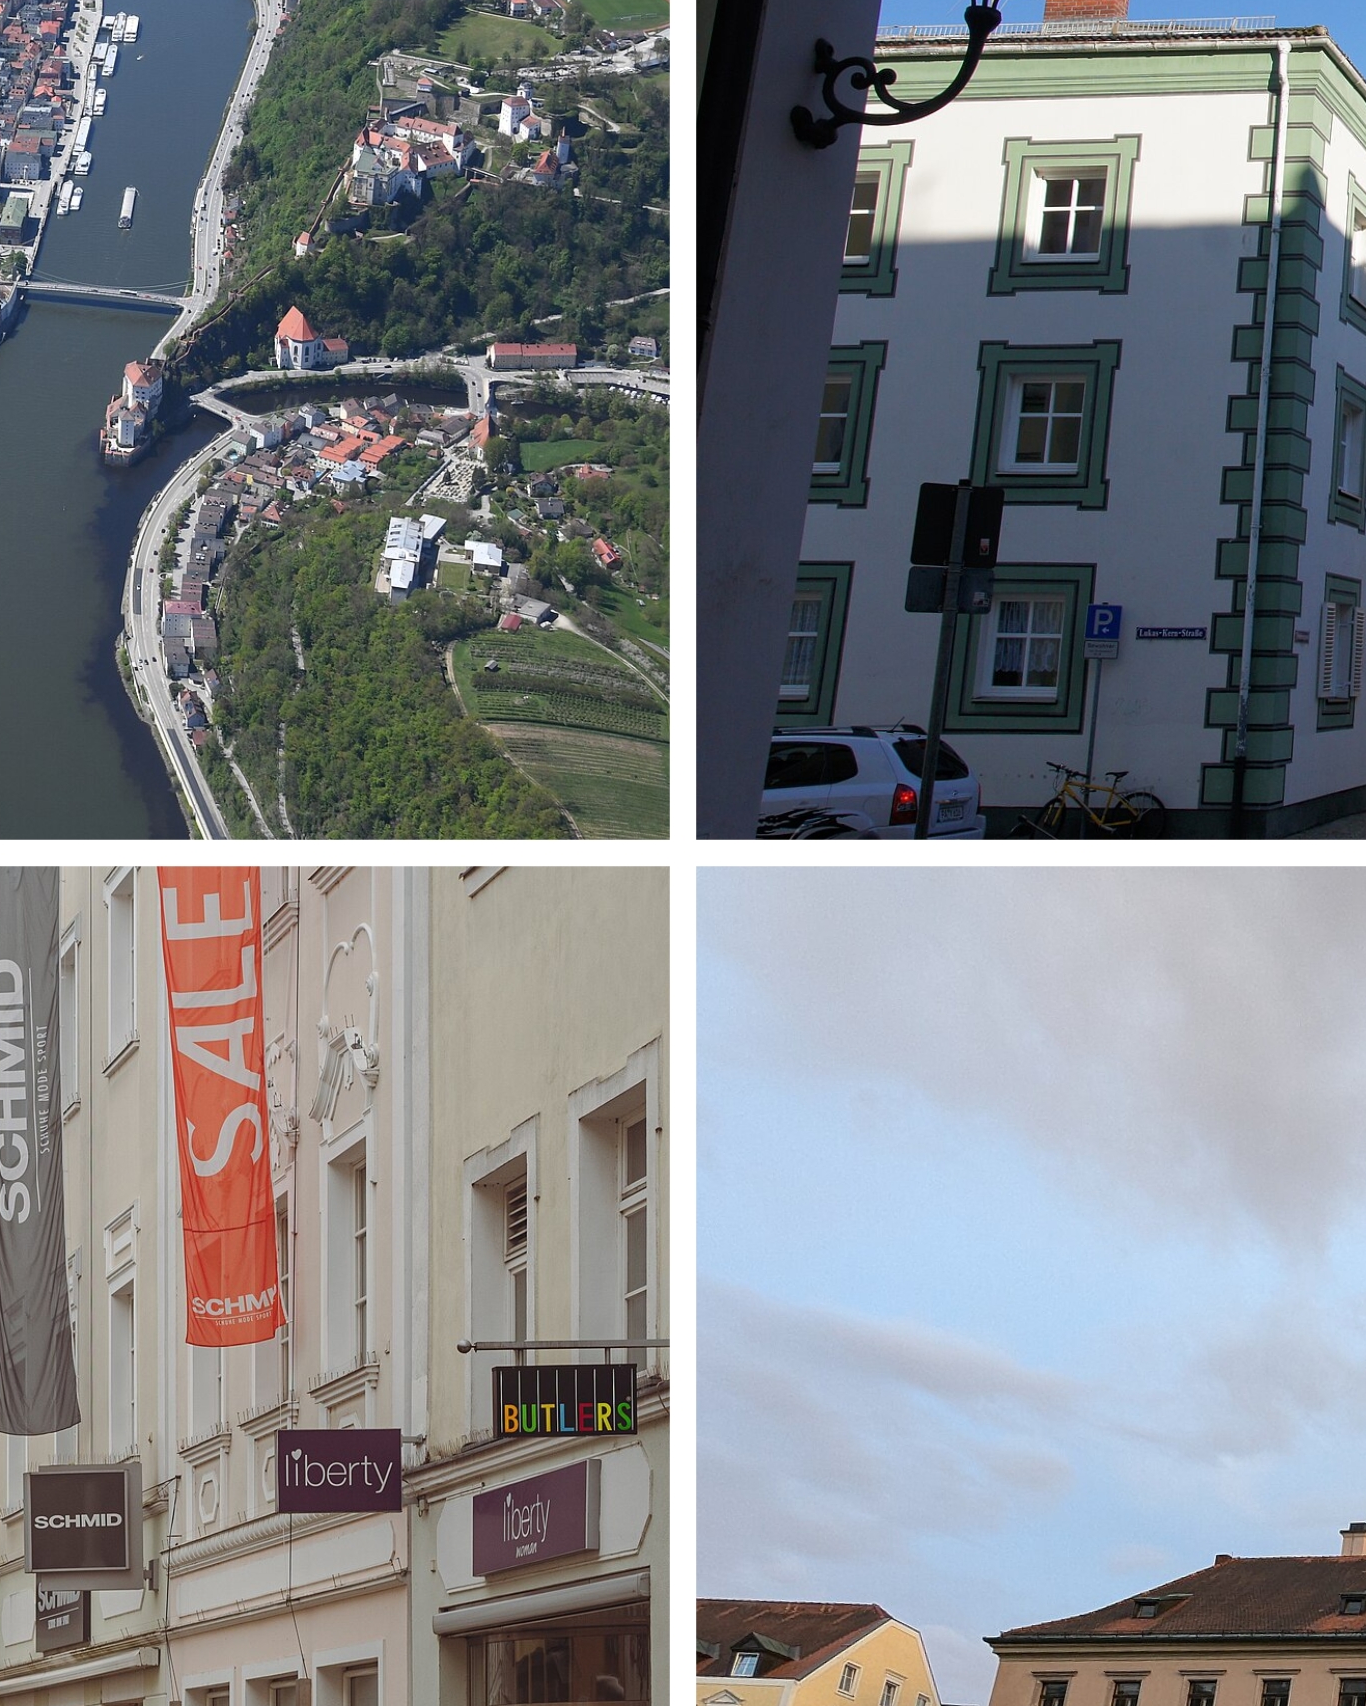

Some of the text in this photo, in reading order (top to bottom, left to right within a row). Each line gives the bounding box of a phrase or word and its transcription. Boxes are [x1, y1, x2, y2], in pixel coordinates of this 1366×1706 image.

[1093, 609, 1113, 635] P
[1139, 628, 1204, 637] Lukas-Kern-Straße
[163, 880, 263, 1179] SALE
[36, 1024, 51, 1155] SCHUHE MODE SPORT
[504, 1402, 633, 1433] BUTLERS
[285, 1449, 393, 1493] liberty
[34, 1513, 123, 1530] SCHMID
[502, 1493, 550, 1543] liberty
